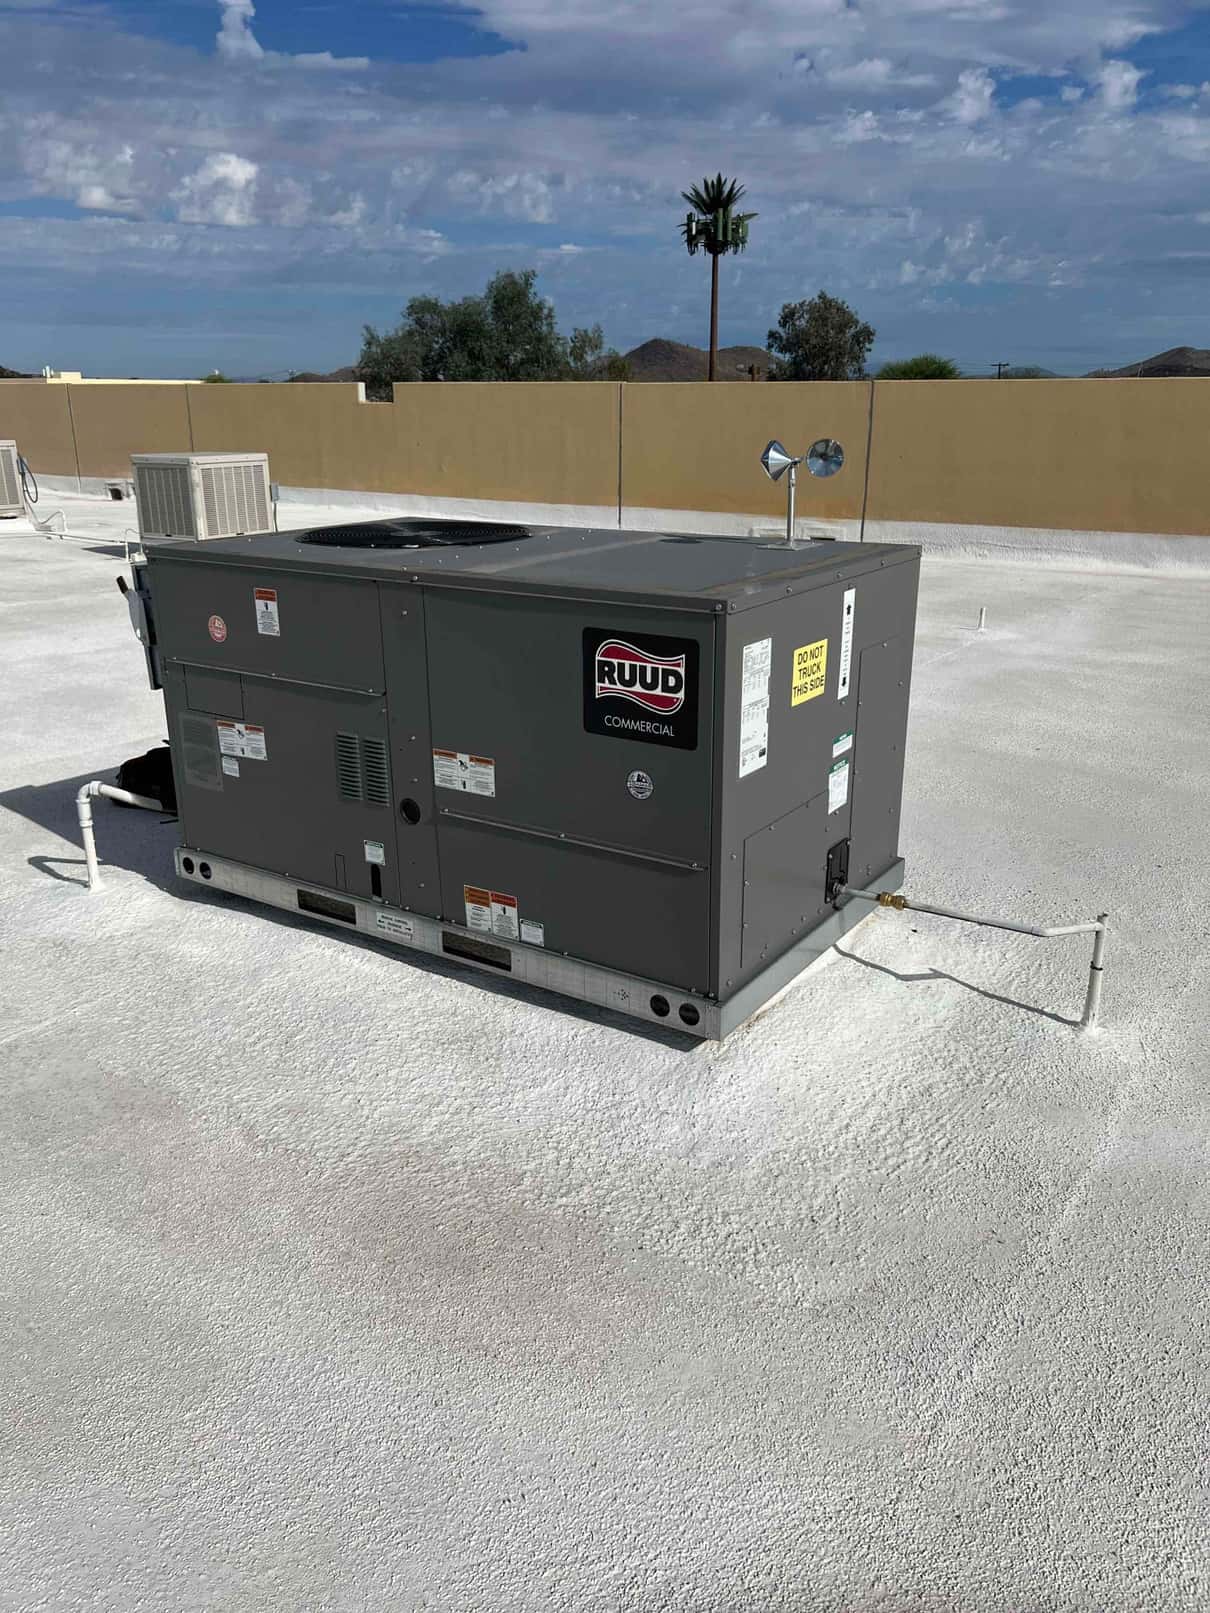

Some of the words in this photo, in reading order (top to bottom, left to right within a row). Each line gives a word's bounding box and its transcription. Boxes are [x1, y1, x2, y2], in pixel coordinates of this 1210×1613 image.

[797, 651, 808, 665] DO
[809, 645, 825, 661] NOT
[597, 660, 684, 695] RUUD
[798, 662, 821, 680] TRUCK
[792, 683, 808, 699] THIS
[809, 675, 825, 692] SIDE
[604, 715, 675, 737] COMMERCIAL
